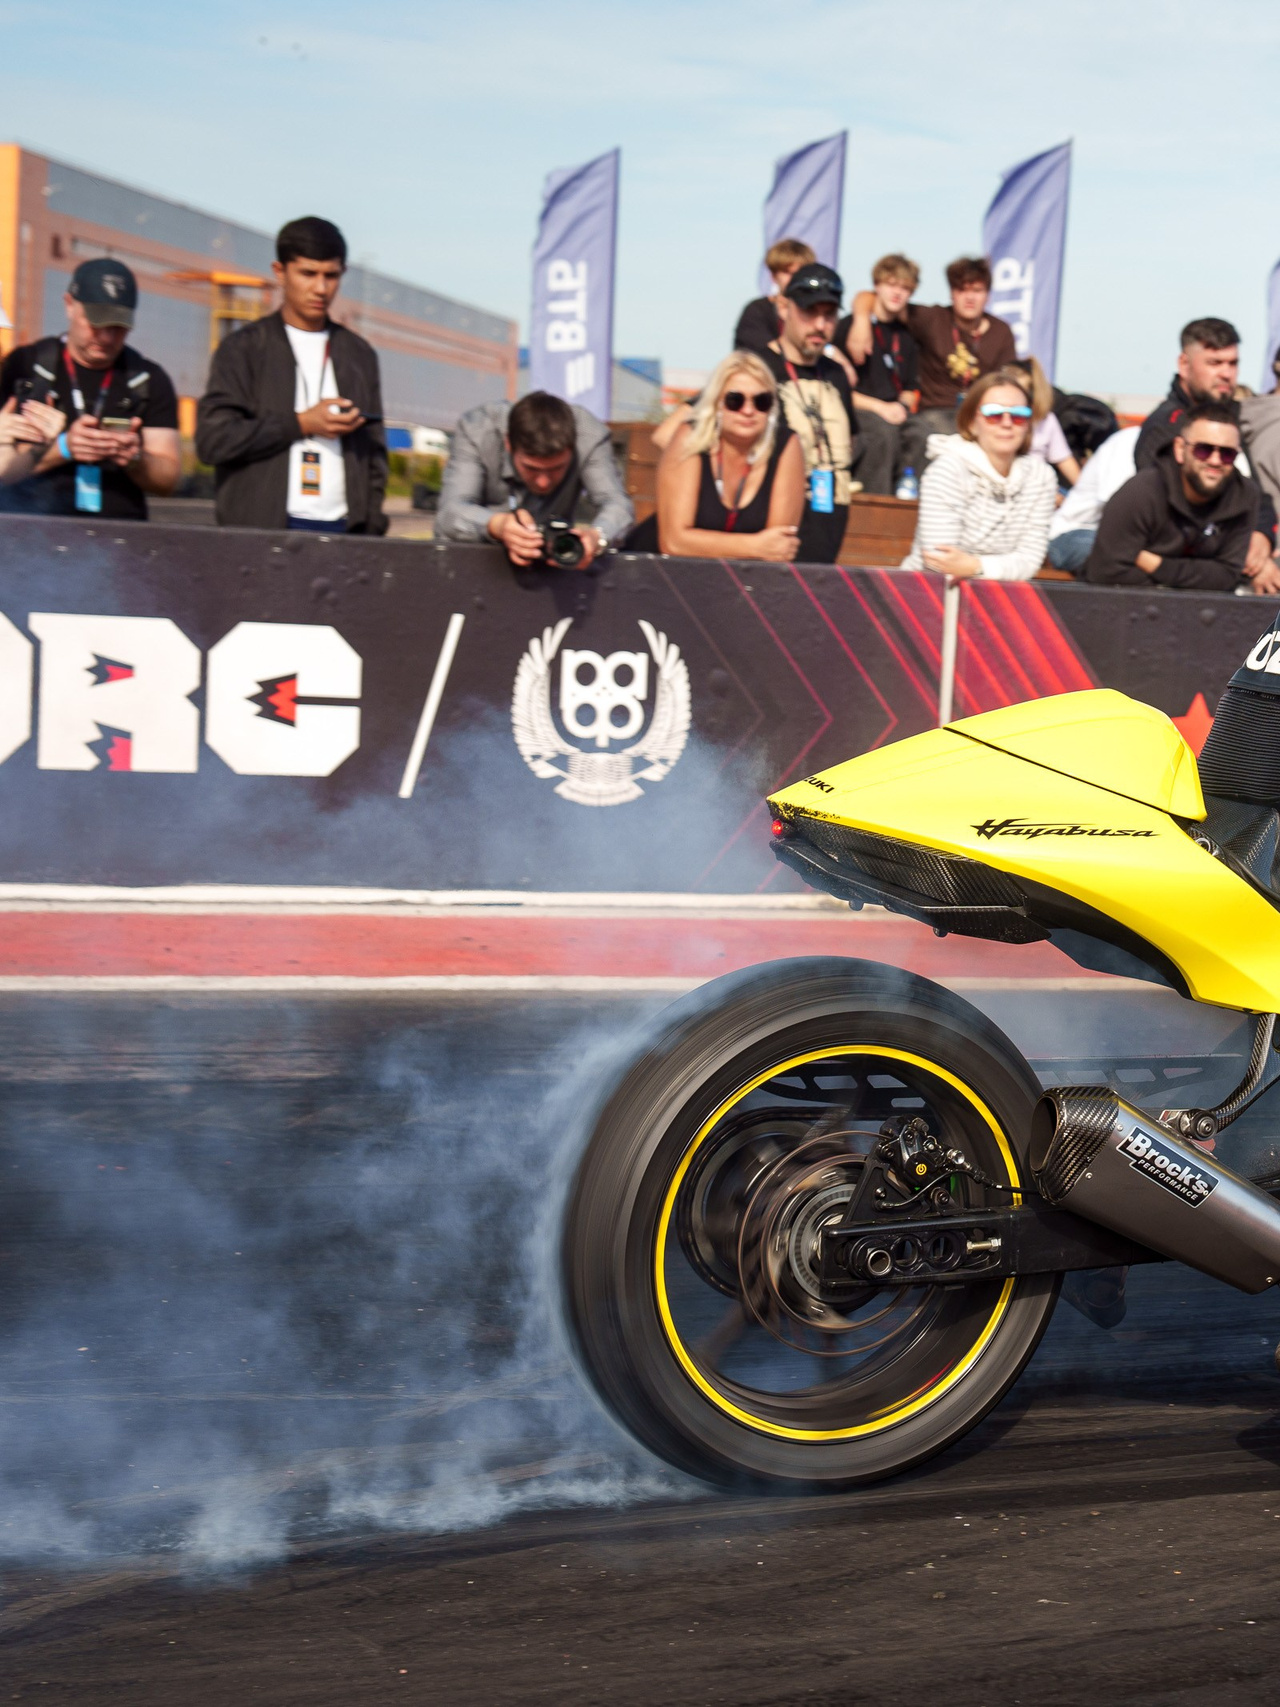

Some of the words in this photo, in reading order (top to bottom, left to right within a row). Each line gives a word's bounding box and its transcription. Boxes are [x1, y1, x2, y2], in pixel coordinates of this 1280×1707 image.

[970, 818, 1161, 840] Hayabusa
[1126, 1132, 1209, 1194] Brock's
[1138, 1159, 1199, 1201] PERFORMANCE
